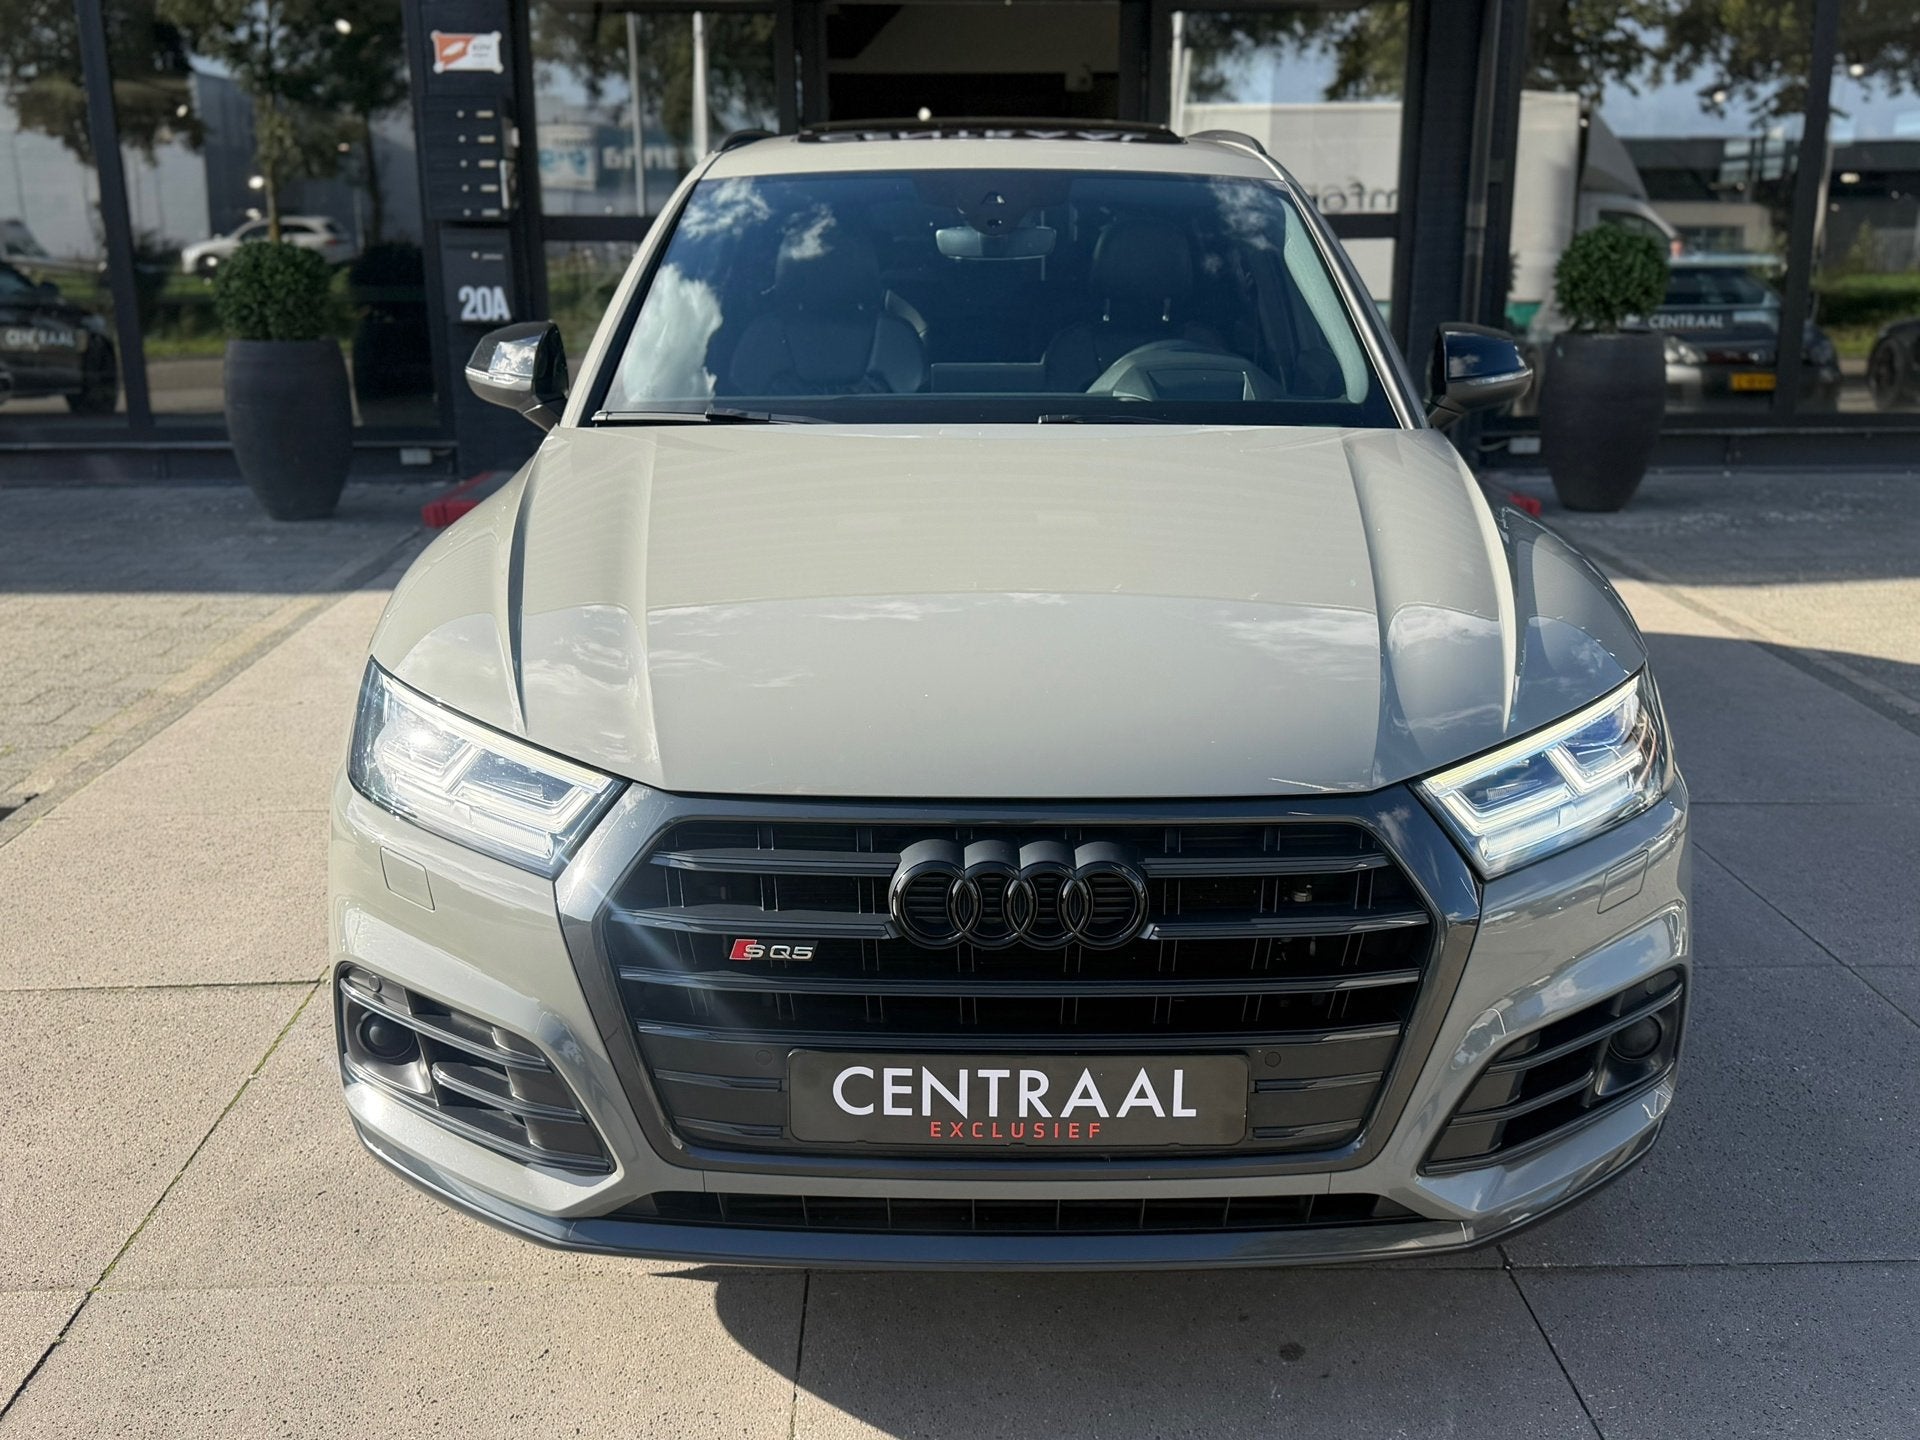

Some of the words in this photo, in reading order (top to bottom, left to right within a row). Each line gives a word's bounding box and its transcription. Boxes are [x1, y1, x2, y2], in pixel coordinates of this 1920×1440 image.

[458, 286, 512, 321] 20A
[1648, 313, 1724, 329] CENTRAAL
[743, 944, 814, 960] SQ5
[832, 1066, 1197, 1119] CENTRAAL
[929, 1121, 1101, 1139] EXCLUSIEF
